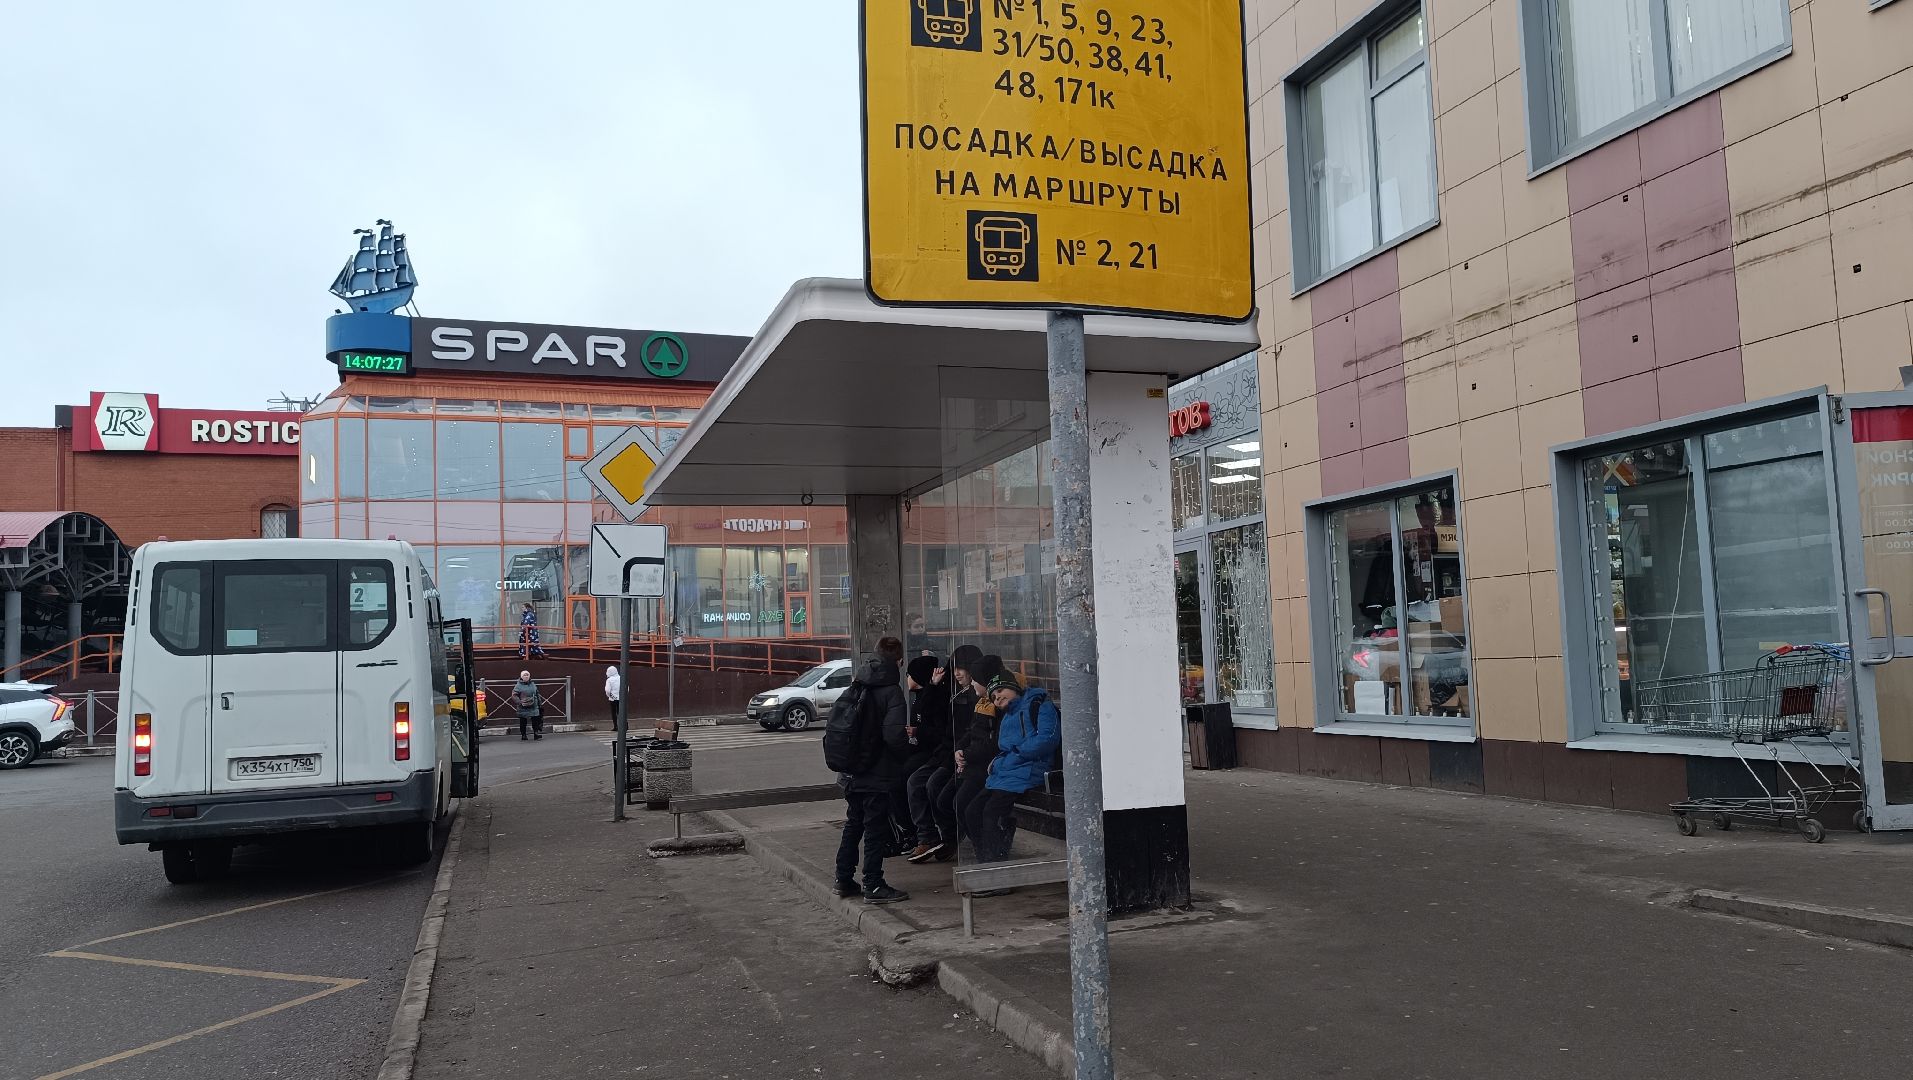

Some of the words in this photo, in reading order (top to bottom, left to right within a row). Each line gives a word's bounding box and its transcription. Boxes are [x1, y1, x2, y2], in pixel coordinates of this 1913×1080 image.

[993, 0, 1024, 20] №
[1032, 0, 1049, 29] 1,
[1061, 3, 1084, 35] 5,
[1096, 9, 1119, 41] 9,
[1131, 15, 1173, 49] 23,
[993, 28, 1079, 68] 31/50,
[1089, 43, 1129, 78] 38,
[1134, 52, 1172, 83] 41,
[994, 69, 1043, 103] 48,
[1054, 77, 1115, 109] 171к
[895, 123, 1227, 181] ПОСАДКА/ВЫСАДКА
[935, 170, 980, 196] НА
[993, 172, 1180, 215] МАРШРУТЫ
[1056, 239, 1086, 265] №
[1097, 240, 1120, 270] 2,
[1129, 242, 1158, 270] 21
[345, 355, 403, 370] 14:07:27
[431, 327, 627, 368] SPAR
[191, 420, 300, 444] ROSTIC
[354, 588, 364, 603] 2
